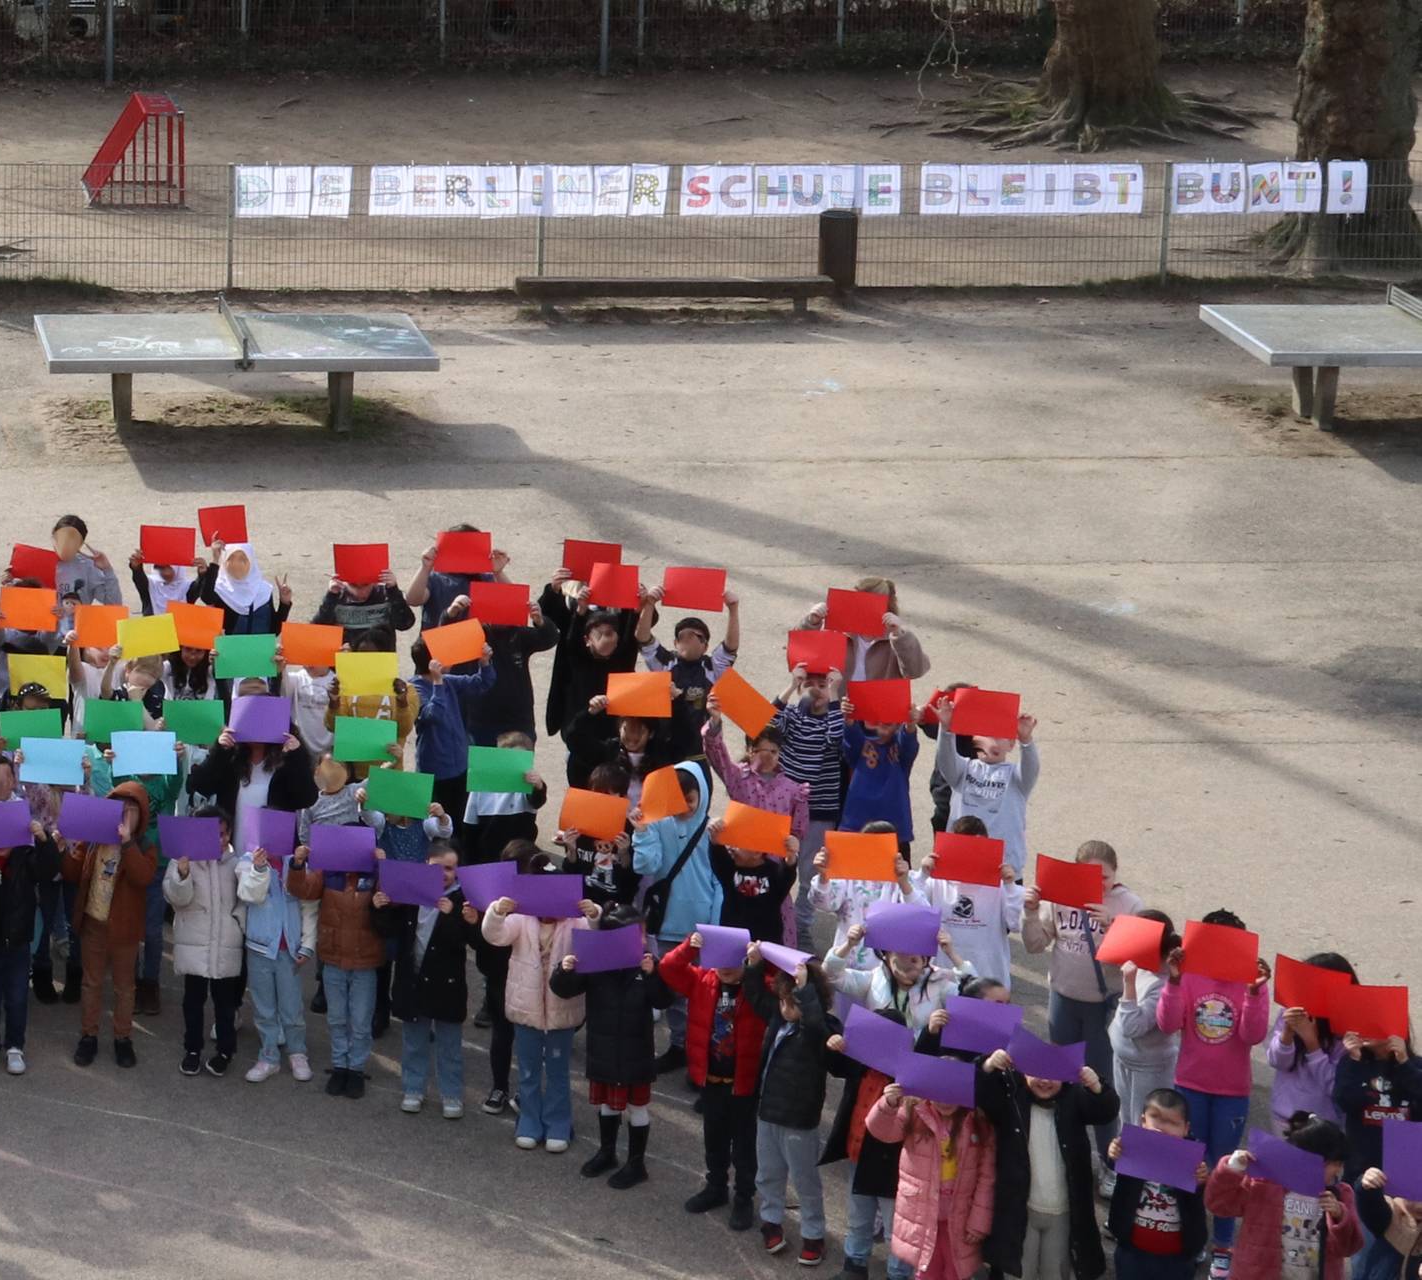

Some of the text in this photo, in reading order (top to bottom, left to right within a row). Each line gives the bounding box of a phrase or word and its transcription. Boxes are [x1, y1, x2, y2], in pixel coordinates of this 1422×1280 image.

[237, 174, 342, 208] DIE
[374, 174, 662, 208] BERLINER
[688, 174, 893, 208] SCHULE
[925, 171, 1139, 207] BLEIBT
